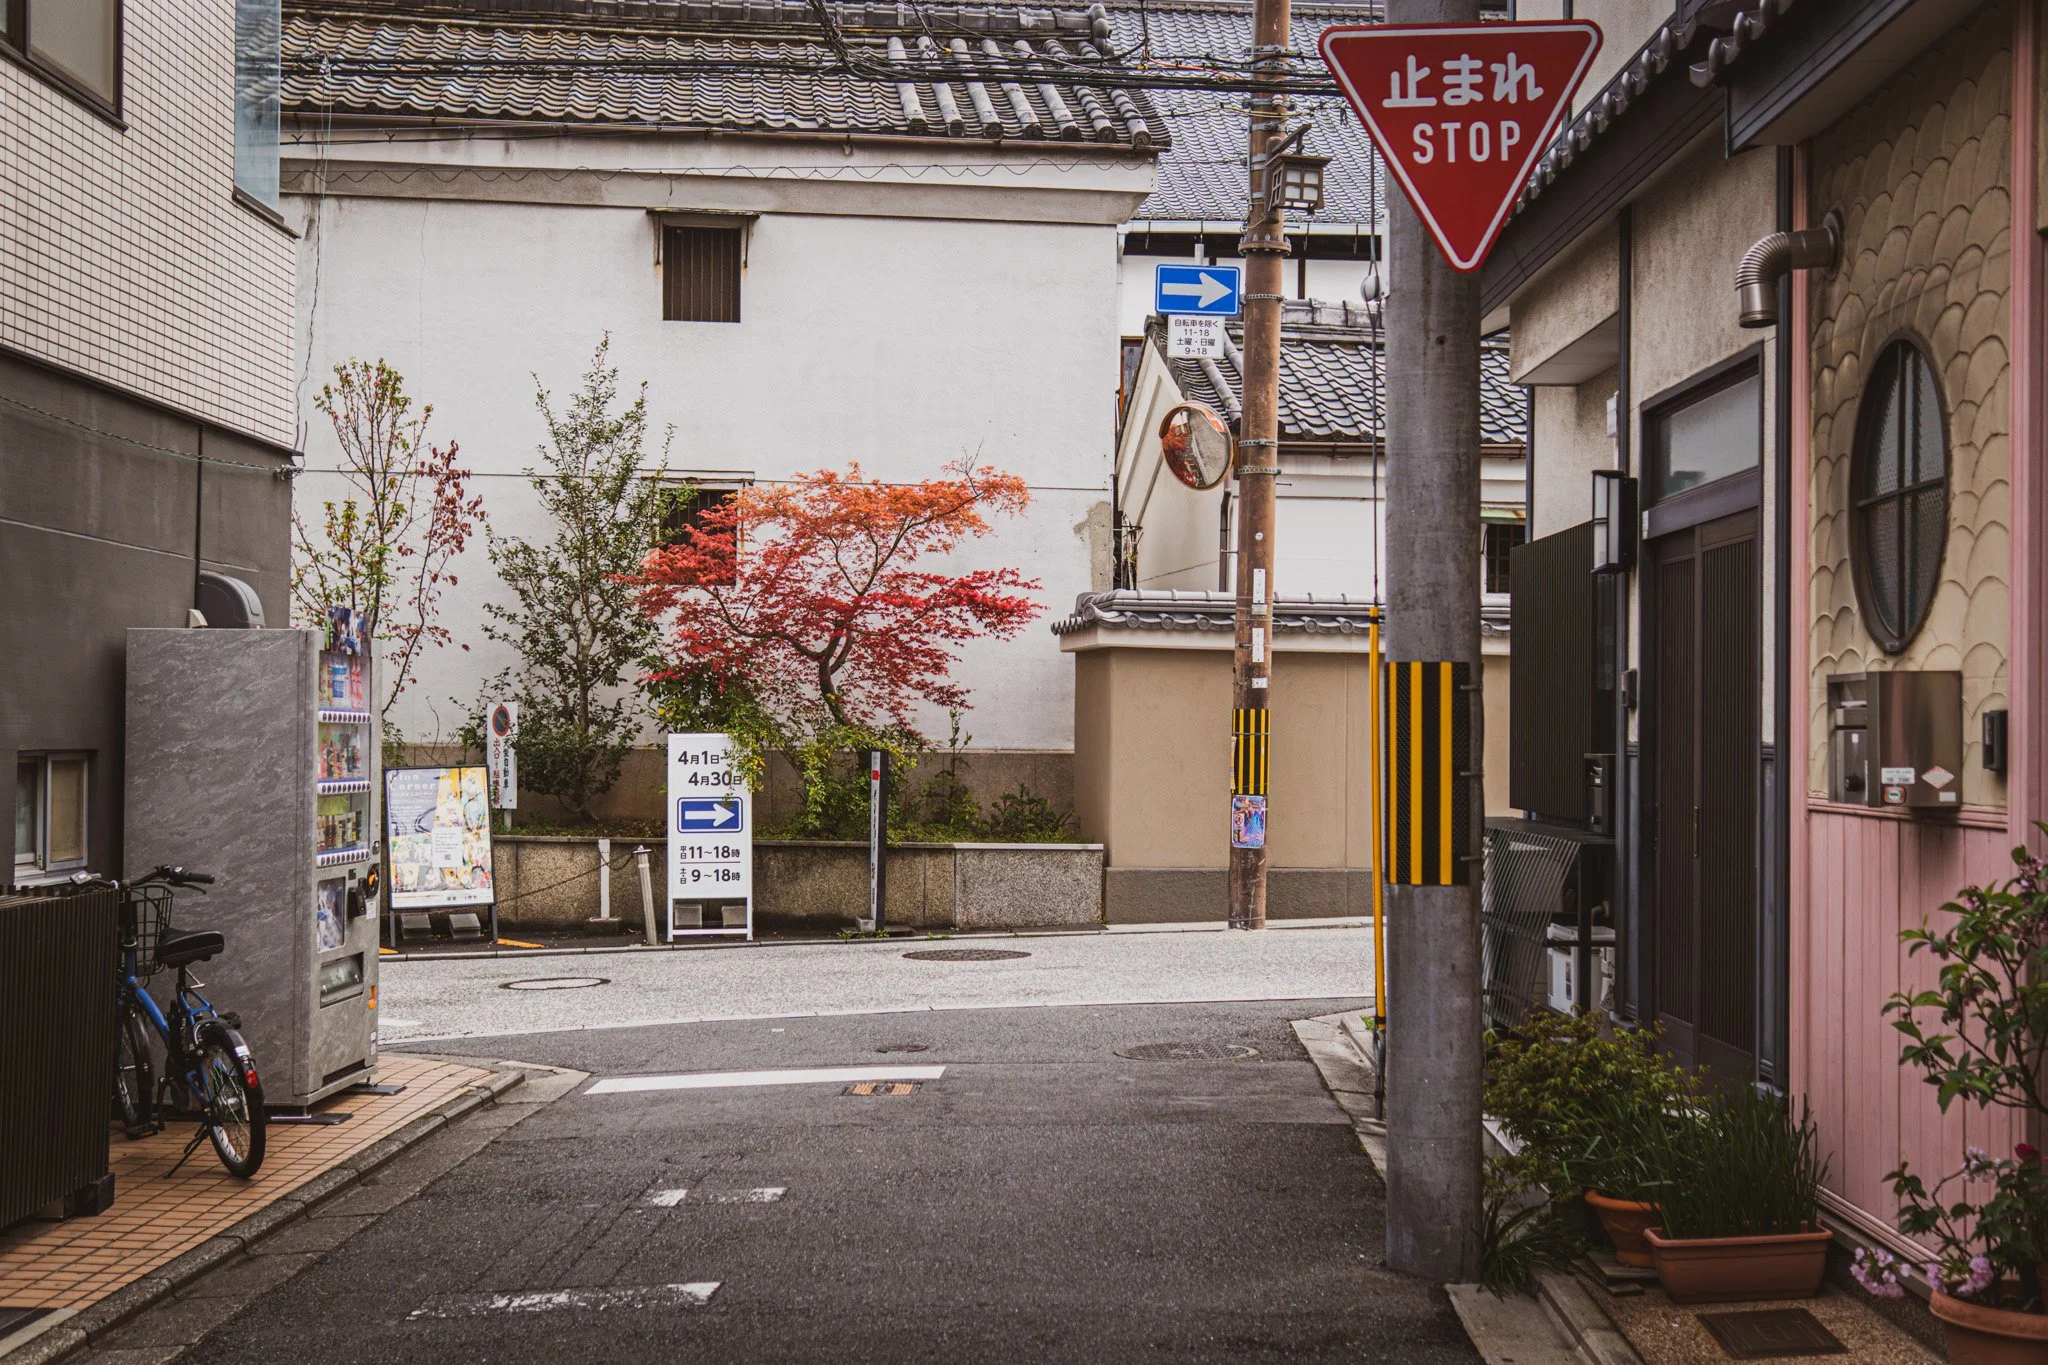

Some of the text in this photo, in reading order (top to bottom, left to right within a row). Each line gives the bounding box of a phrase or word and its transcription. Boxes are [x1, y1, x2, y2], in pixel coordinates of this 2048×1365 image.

[1382, 52, 1544, 108] 止まれ
[1412, 120, 1521, 165] STOP
[1174, 318, 1219, 328] 自転車を除く
[1184, 328, 1210, 337] 11-18
[1185, 347, 1208, 355] 9-18
[688, 771, 742, 786] 4月30日
[390, 783, 436, 791] Corner
